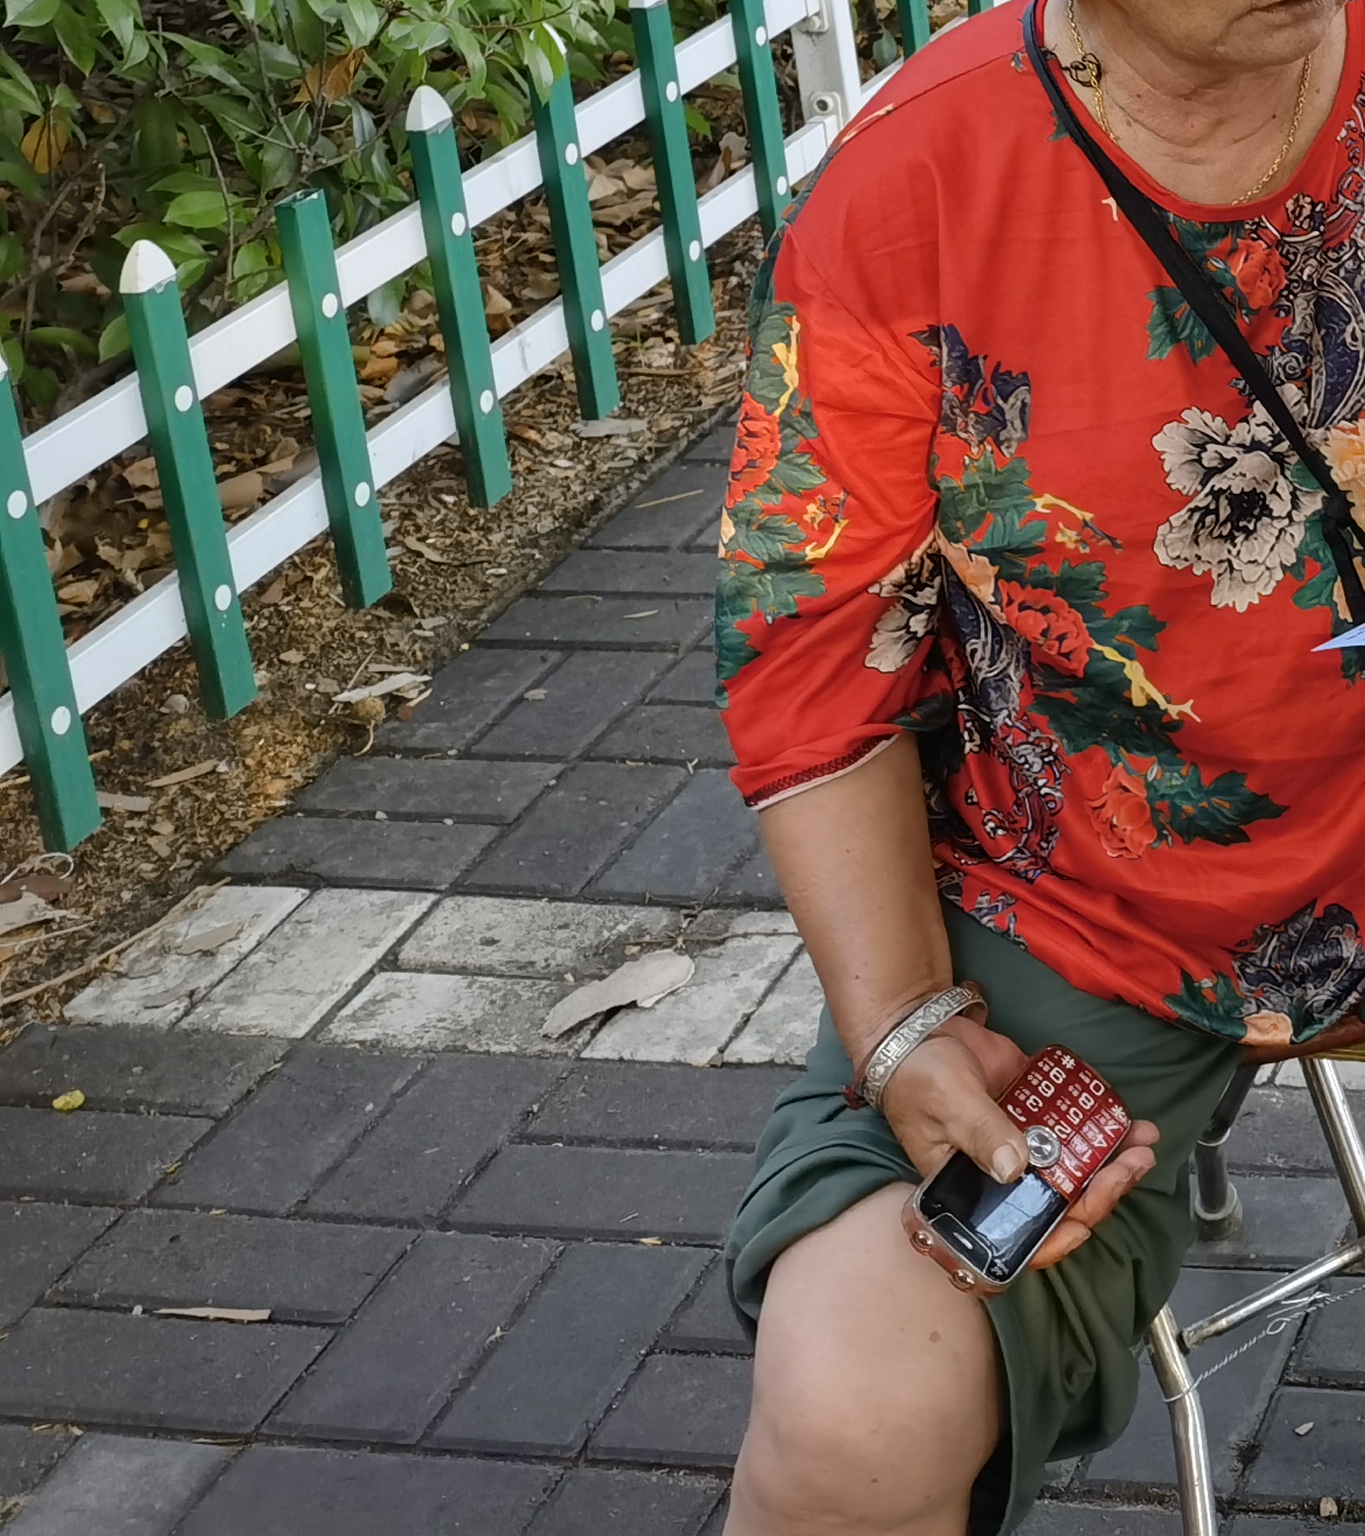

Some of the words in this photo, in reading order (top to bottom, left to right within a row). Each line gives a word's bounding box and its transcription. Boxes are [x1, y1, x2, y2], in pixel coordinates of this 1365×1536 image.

[1050, 1066, 1067, 1084] 9
[1038, 1080, 1056, 1098] 6
[1089, 1079, 1106, 1096] 0
[1025, 1095, 1044, 1112] 3
[1078, 1092, 1095, 1110] 8
[1066, 1107, 1084, 1125] 5
[1053, 1120, 1073, 1139] 2
[1103, 1124, 1123, 1138] 7
[1092, 1133, 1108, 1148] 4
